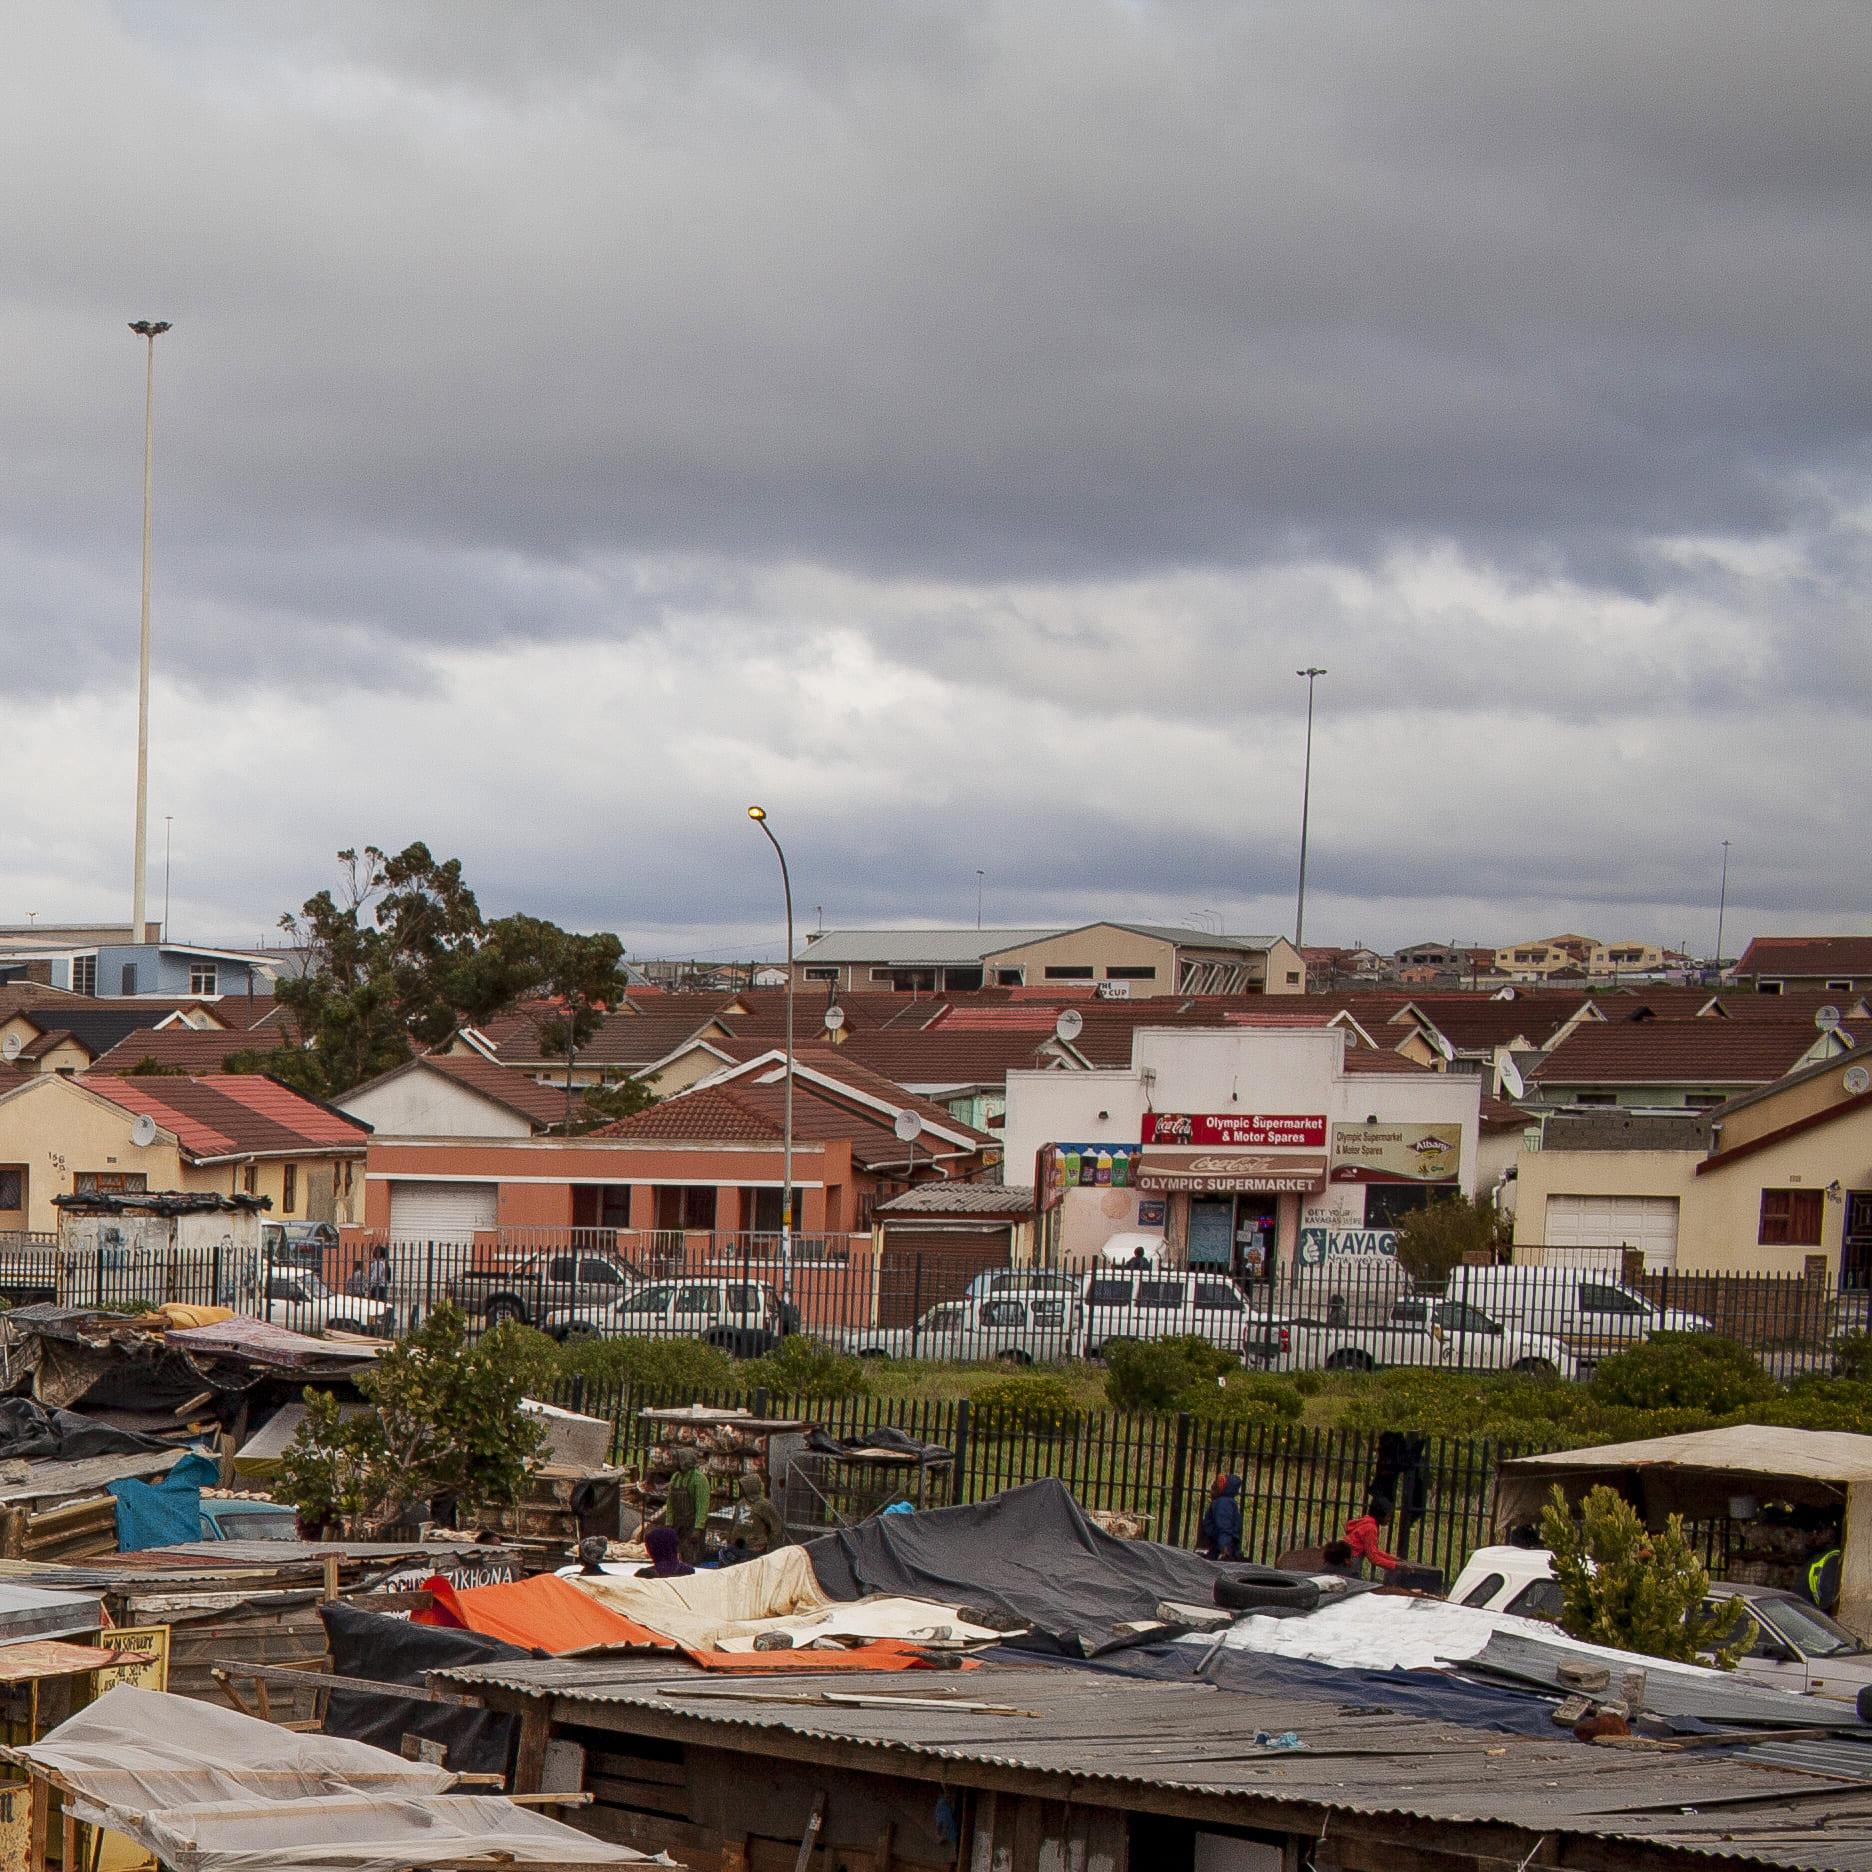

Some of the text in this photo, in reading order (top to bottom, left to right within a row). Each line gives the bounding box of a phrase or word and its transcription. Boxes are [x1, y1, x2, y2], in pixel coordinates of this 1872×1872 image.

[1206, 1116, 1251, 1130] Olympic
[1253, 1115, 1323, 1130] Supermarket
[1222, 1132, 1305, 1143] & Motor Spares
[1336, 1131, 1403, 1142] Olympic Supermarket
[1343, 1146, 1360, 1154] Motor
[1362, 1146, 1383, 1156] Spares
[1140, 1178, 1316, 1191] OLYMPIC SUPERMARKET
